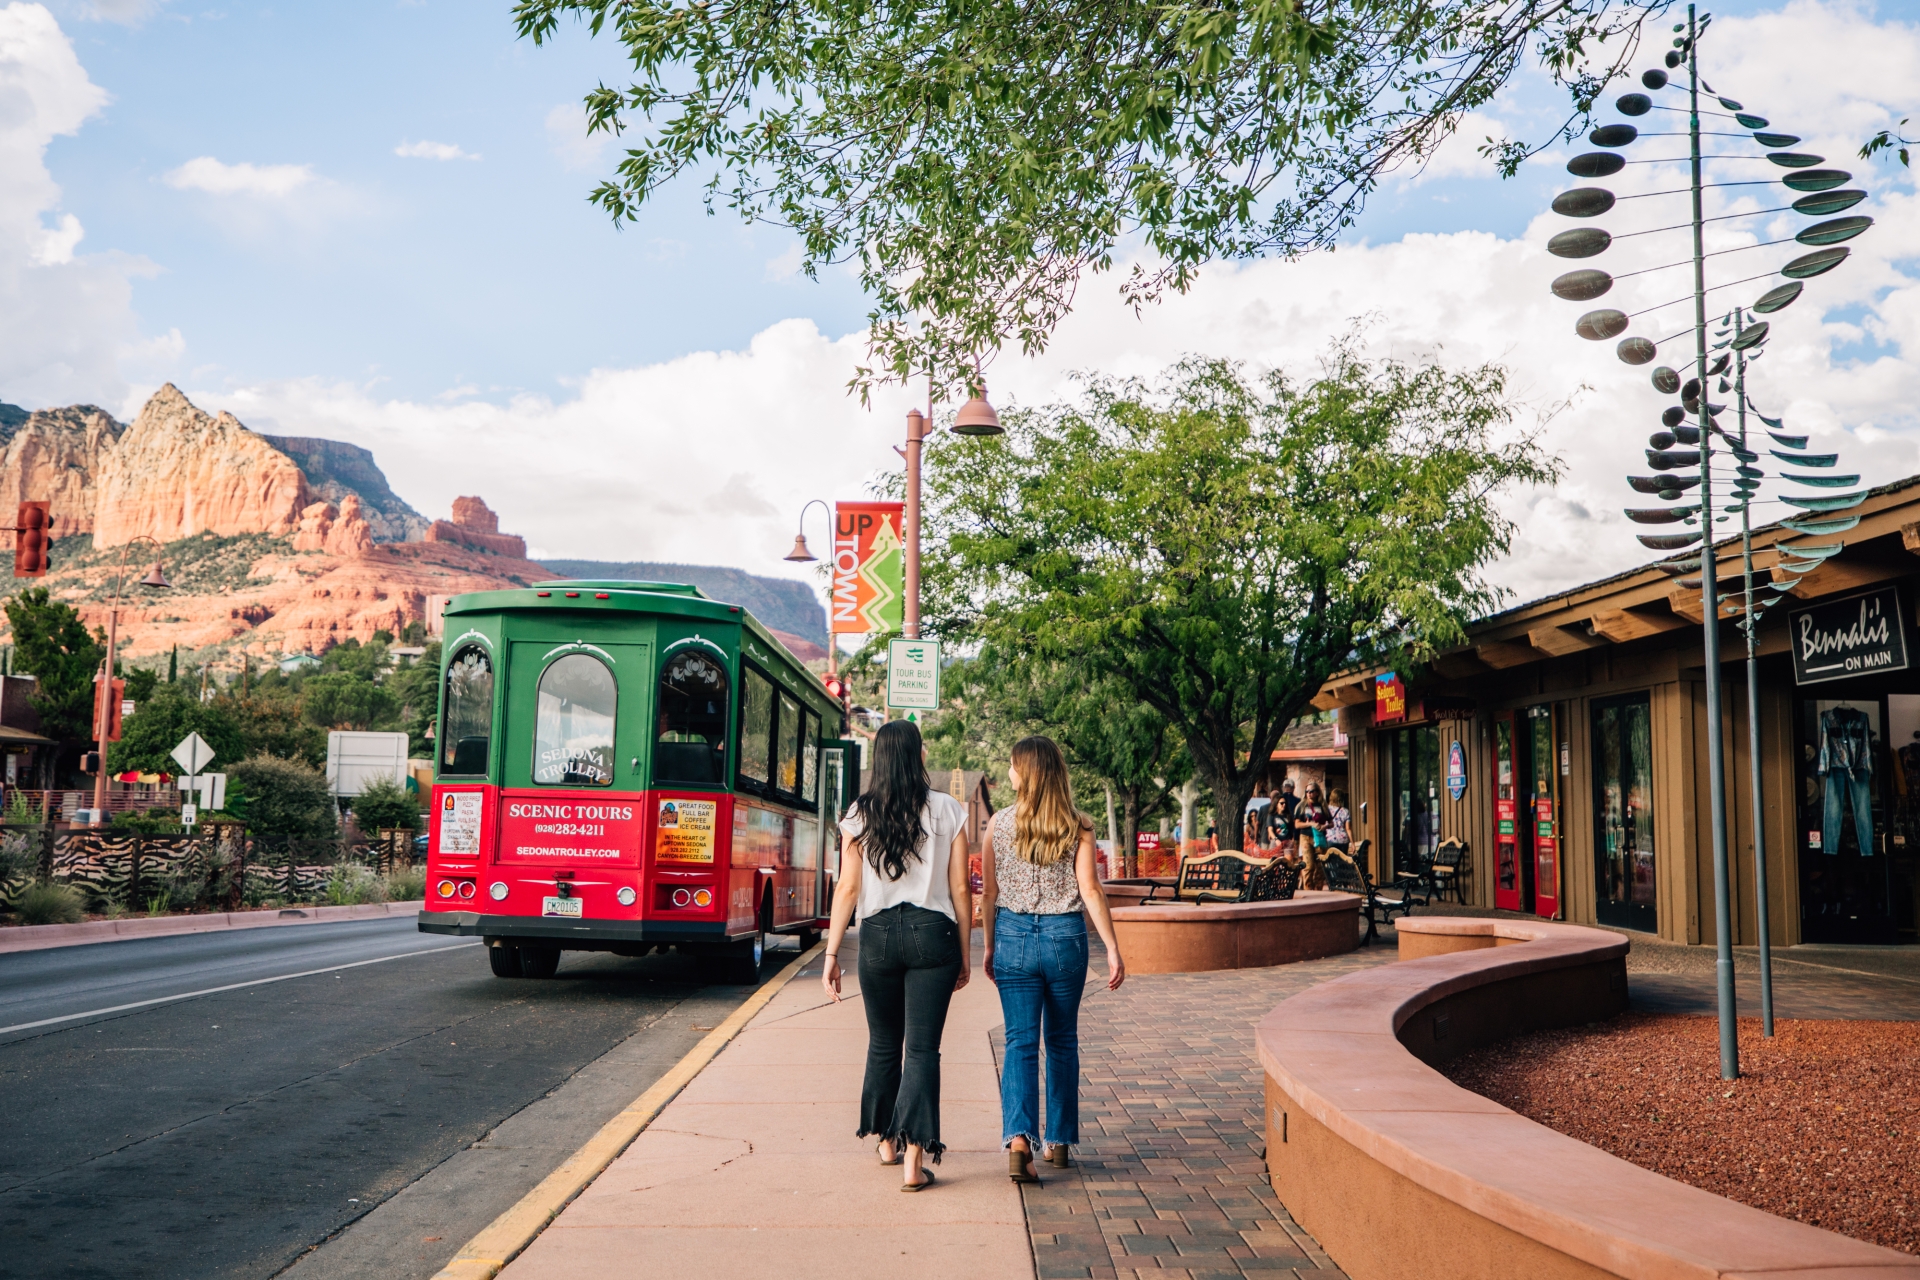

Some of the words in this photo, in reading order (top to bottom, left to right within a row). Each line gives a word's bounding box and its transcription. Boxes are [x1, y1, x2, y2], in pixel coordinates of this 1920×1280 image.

[836, 514, 873, 536] UP
[833, 535, 859, 622] TOWN
[1845, 656, 1862, 671] ON
[1864, 650, 1892, 668] MAIN
[896, 668, 915, 678] TOUR
[917, 669, 932, 678] BUS
[898, 680, 929, 690] PARKING
[1385, 696, 1405, 714] Trolley
[541, 748, 604, 767] SEDONA
[539, 761, 607, 781] TROLLEY
[509, 803, 572, 819] SCENIC
[575, 805, 633, 820] TOURS
[535, 823, 604, 836] (928)282-4211
[1138, 833, 1159, 842] ATM
[516, 846, 620, 858] SEDONATROLLEY.COM
[546, 901, 579, 913] CM20105
